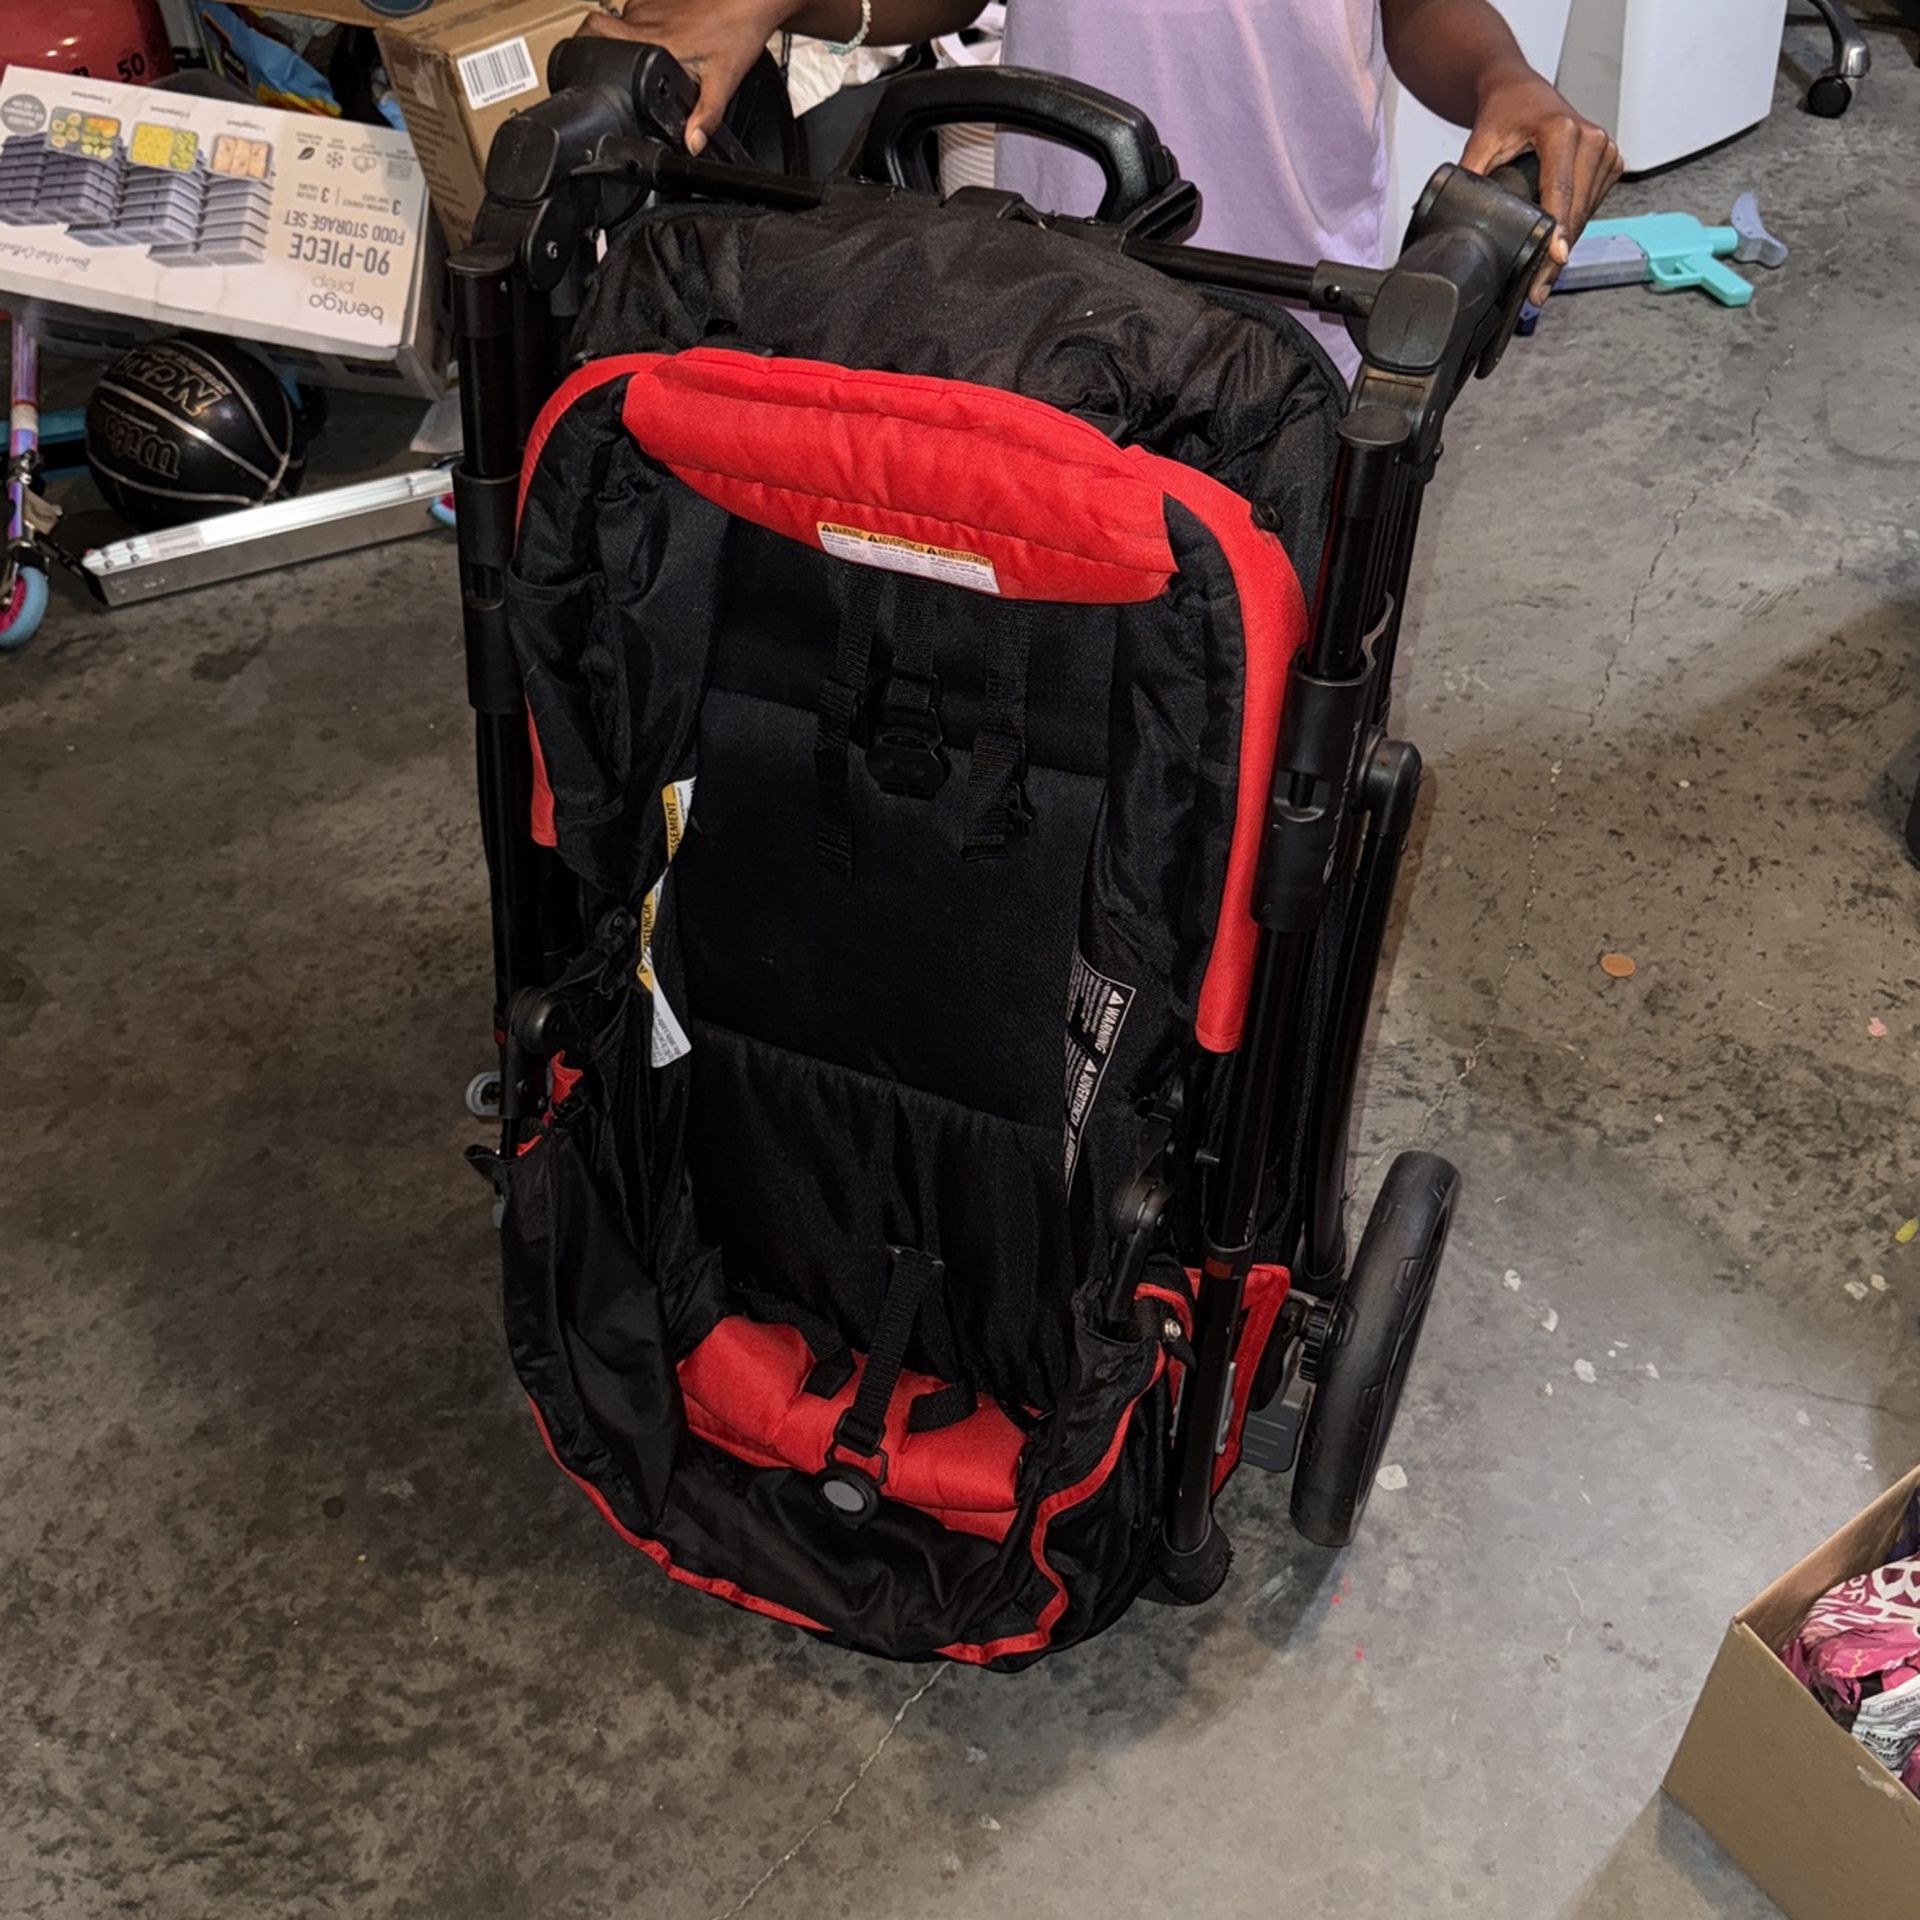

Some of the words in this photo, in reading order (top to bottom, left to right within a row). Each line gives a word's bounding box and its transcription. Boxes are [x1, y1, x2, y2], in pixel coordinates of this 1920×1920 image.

[117, 52, 146, 82] 50
[320, 186, 330, 204] 3
[283, 209, 308, 229] SET
[391, 199, 402, 216] 3
[309, 212, 370, 239] STORAGE
[371, 224, 406, 246] FOOD
[287, 232, 391, 276] 90-PIECE
[311, 274, 356, 295] prep
[308, 291, 385, 326] bentgo
[1094, 1005, 1121, 1055] WARNING
